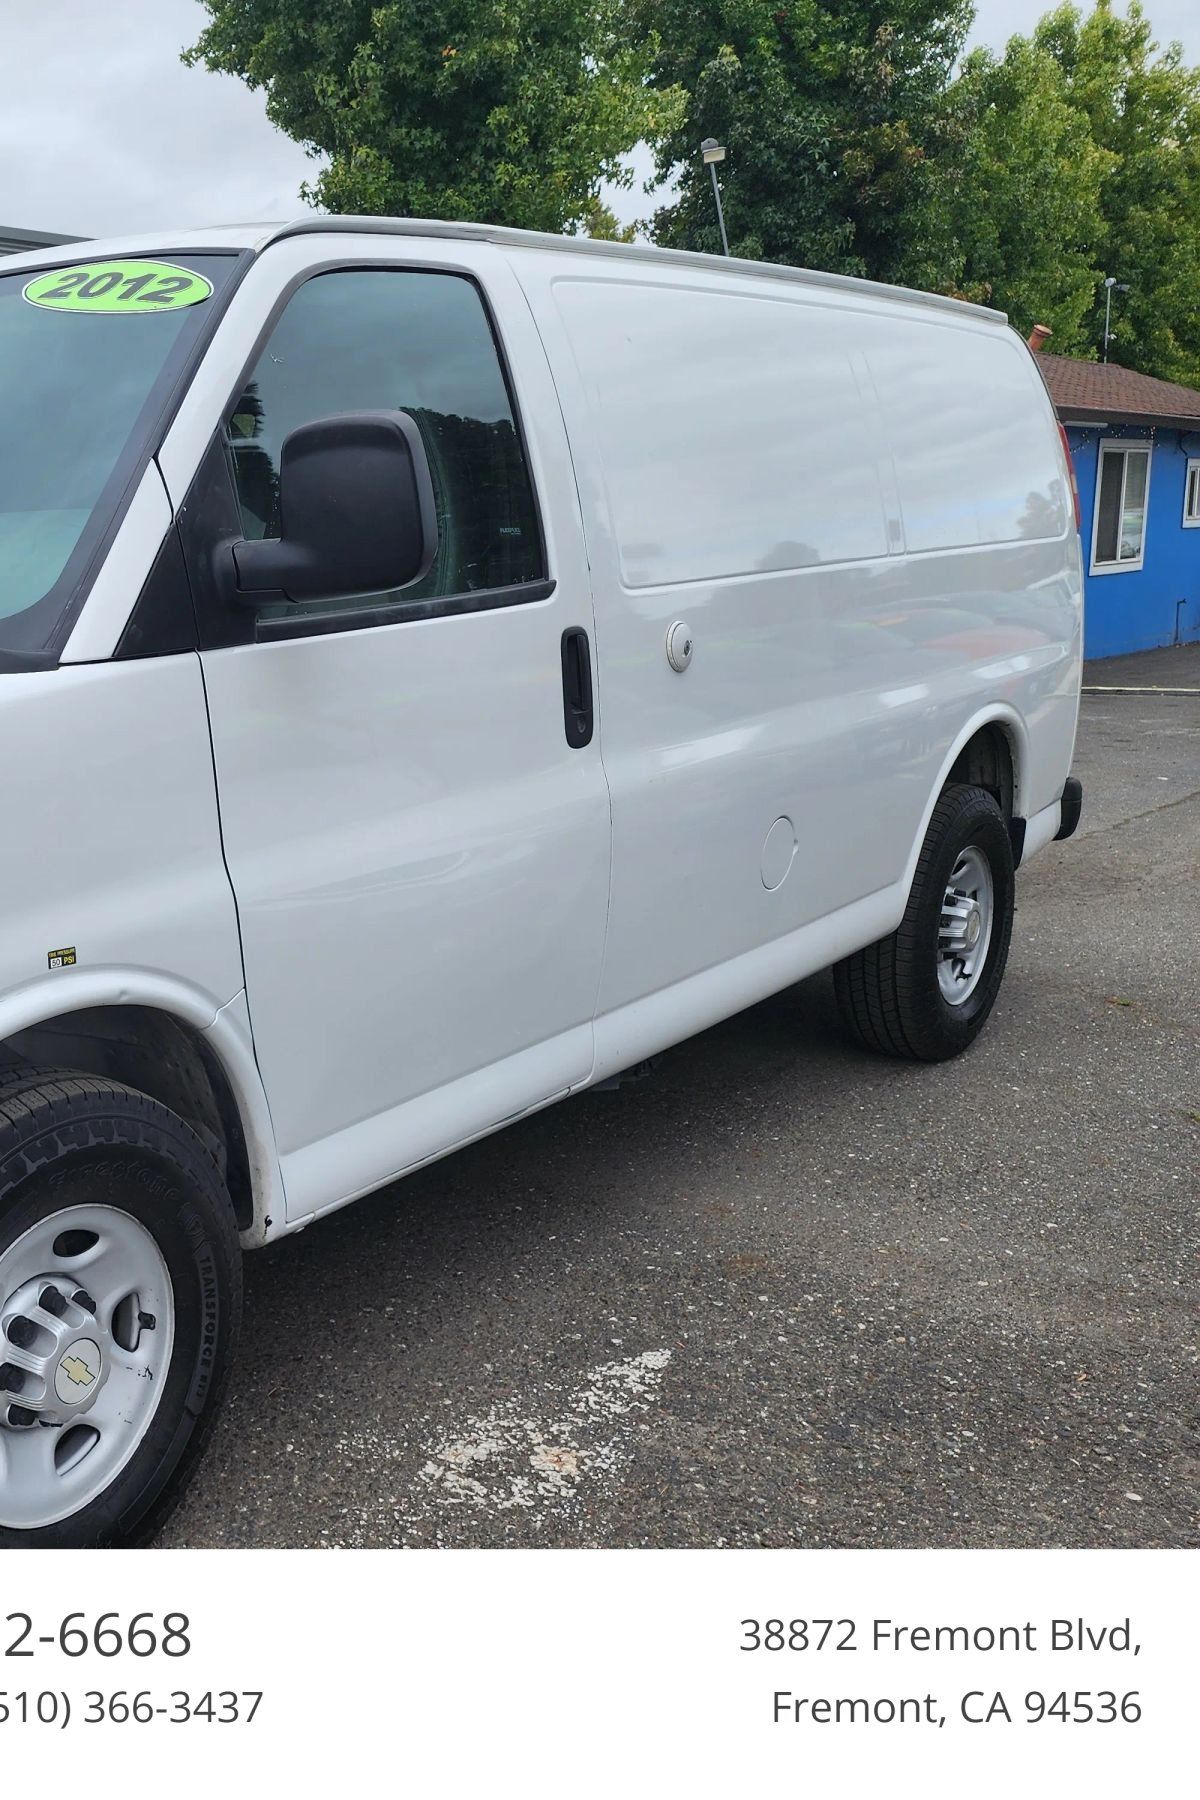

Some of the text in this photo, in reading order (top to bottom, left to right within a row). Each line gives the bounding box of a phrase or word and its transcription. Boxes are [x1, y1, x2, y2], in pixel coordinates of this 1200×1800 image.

[37, 271, 194, 304] 2012
[63, 954, 75, 965] PSI
[199, 1254, 218, 1370] TRANSFORCE
